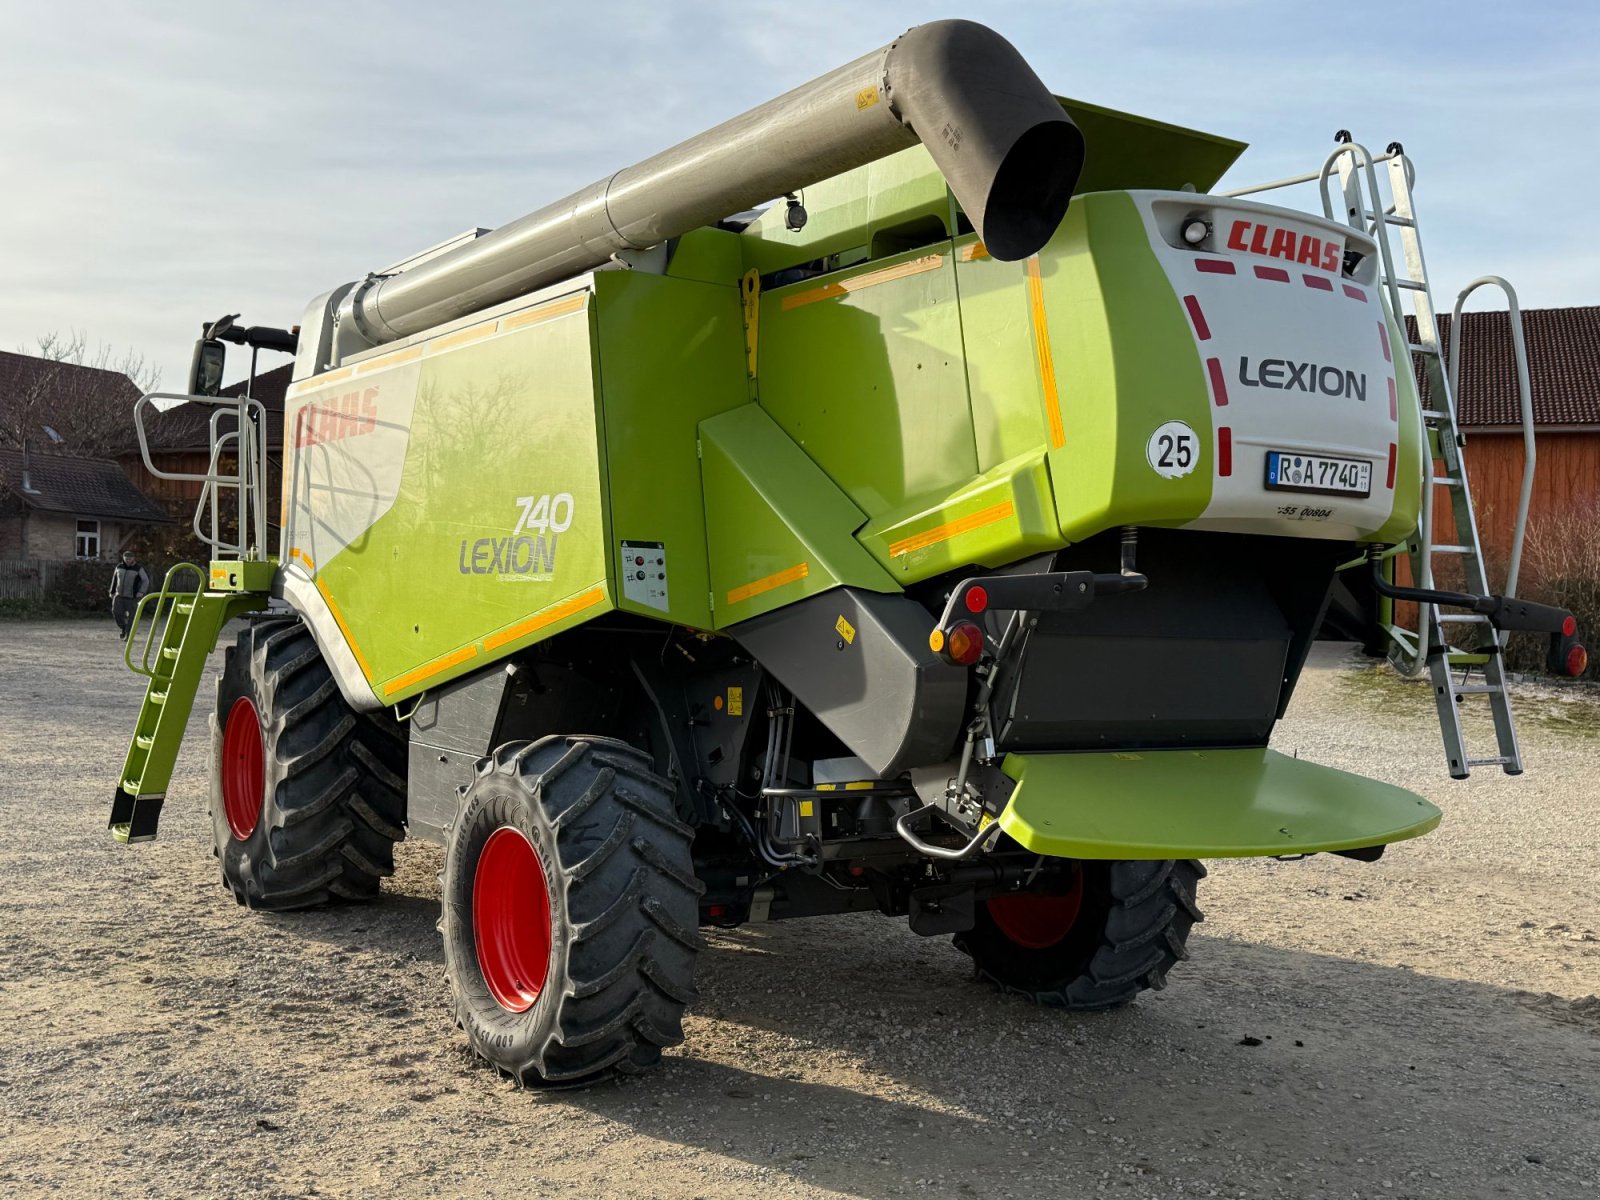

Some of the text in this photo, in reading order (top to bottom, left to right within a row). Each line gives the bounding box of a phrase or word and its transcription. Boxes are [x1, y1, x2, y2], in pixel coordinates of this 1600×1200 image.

[1226, 219, 1341, 273] CLAAS
[1238, 355, 1367, 401] LEXION
[294, 385, 379, 449] CLAAS
[1157, 435, 1192, 467] 25
[1280, 457, 1292, 482] R
[1270, 471, 1276, 480] D
[512, 492, 575, 536] 740
[459, 534, 558, 575] LEXION
